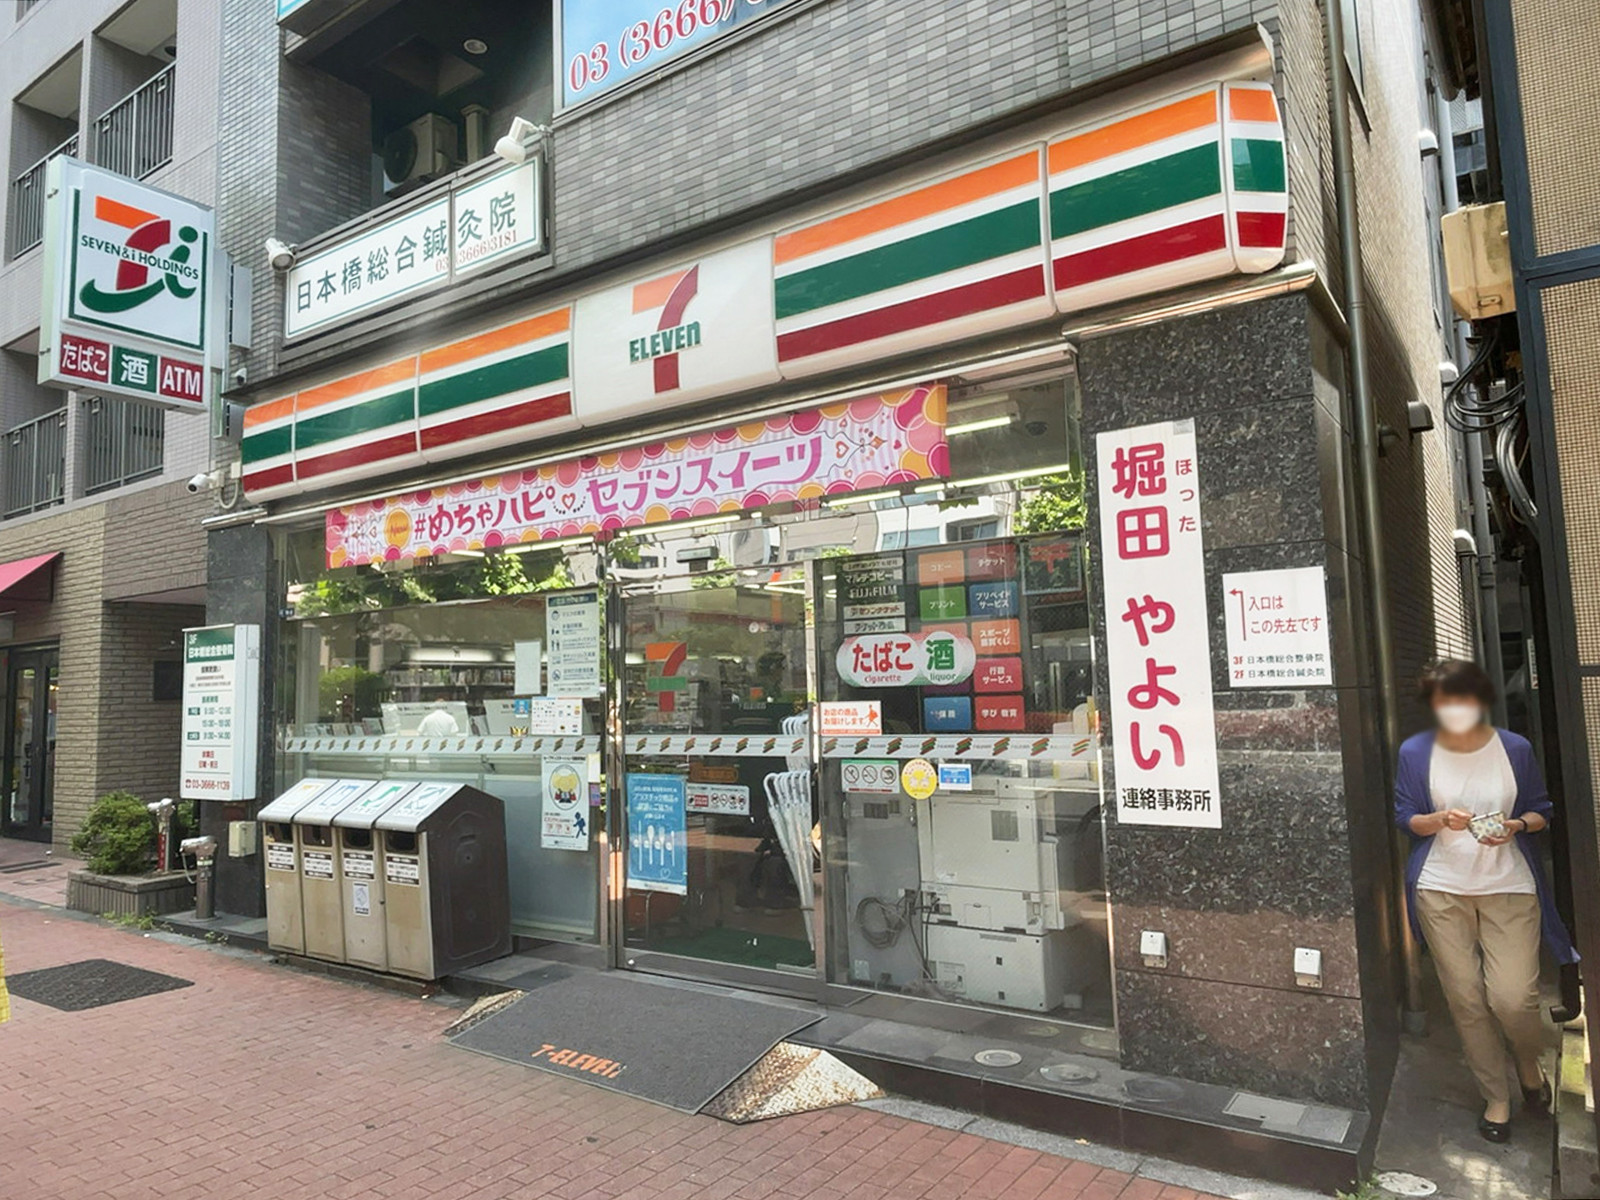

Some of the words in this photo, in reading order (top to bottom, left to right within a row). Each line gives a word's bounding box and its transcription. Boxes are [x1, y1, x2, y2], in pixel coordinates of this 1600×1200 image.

[570, 43, 609, 91] 03
[619, 0, 762, 68] (3666)
[297, 191, 516, 313] 日本橋総合鍼灸院
[138, 253, 200, 280] HOLDINGS
[61, 341, 108, 377] たばこ
[120, 353, 149, 385] 酒
[162, 364, 201, 396] ATM
[586, 435, 822, 515] セブンスイーツ
[1111, 442, 1171, 560] 堀田
[1175, 458, 1197, 533] ほった
[930, 563, 952, 572] コピー
[978, 557, 1006, 567] チケット
[844, 569, 903, 584] マルチコピー
[849, 585, 898, 599] FUJIFILM
[929, 600, 956, 610] プリント
[979, 600, 1010, 610] サービス
[1248, 595, 1284, 611] 入口は
[1250, 616, 1322, 634] この先左です
[852, 640, 914, 673] たばこ
[926, 639, 955, 671] 酒
[1233, 656, 1243, 665] 3F
[1247, 653, 1325, 664] 日本橋総合整骨院
[864, 674, 901, 684] cigarette
[930, 673, 956, 682] liquor
[982, 676, 1013, 684] サービス
[1121, 594, 1186, 771] やよい
[1234, 669, 1244, 679] 2F
[1248, 668, 1326, 678] 日本橋総合鍼灸院
[1122, 787, 1212, 812] 連絡事務所
